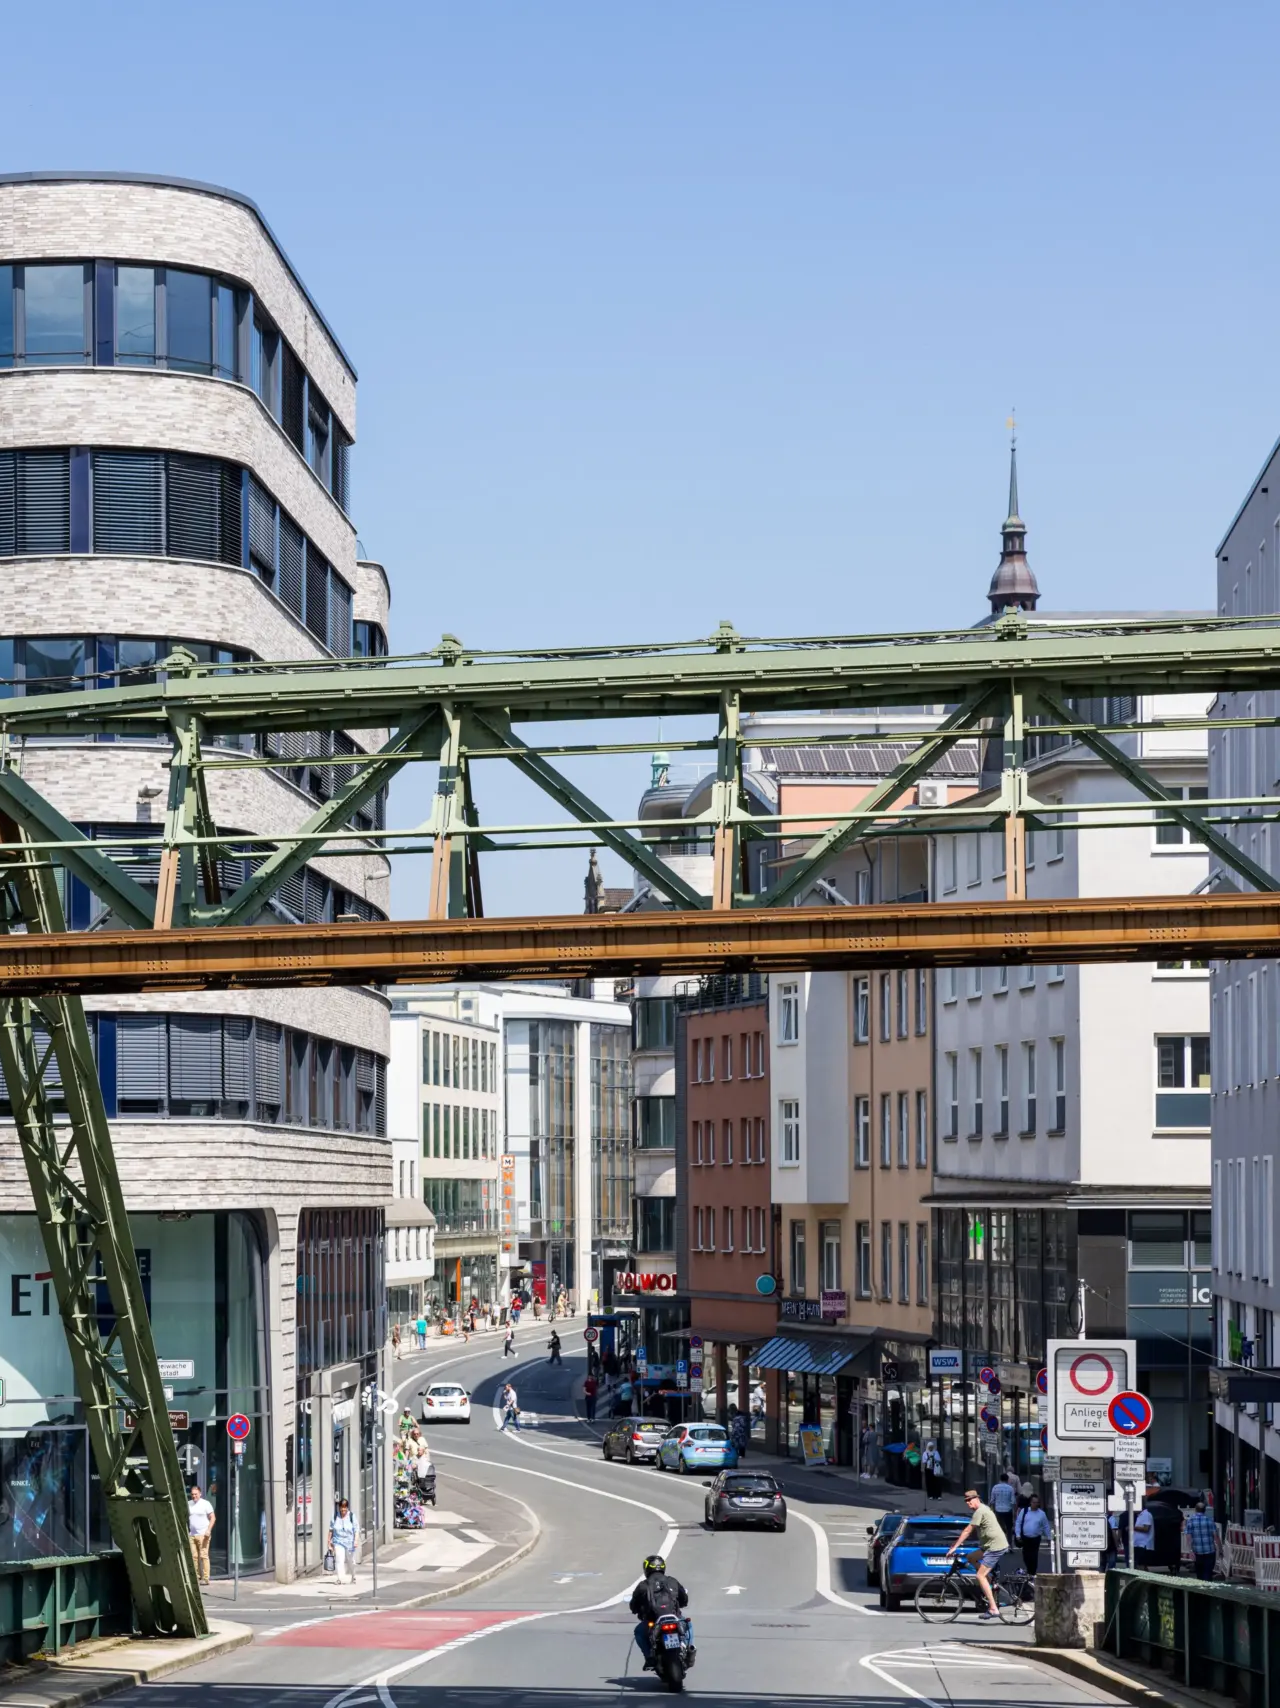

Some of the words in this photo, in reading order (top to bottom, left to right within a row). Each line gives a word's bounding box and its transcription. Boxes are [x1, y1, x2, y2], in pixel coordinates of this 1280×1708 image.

[587, 1331, 595, 1339] 20
[678, 1362, 684, 1370] P
[1070, 1408, 1107, 1419] Anliege
[1083, 1419, 1101, 1428] frei
